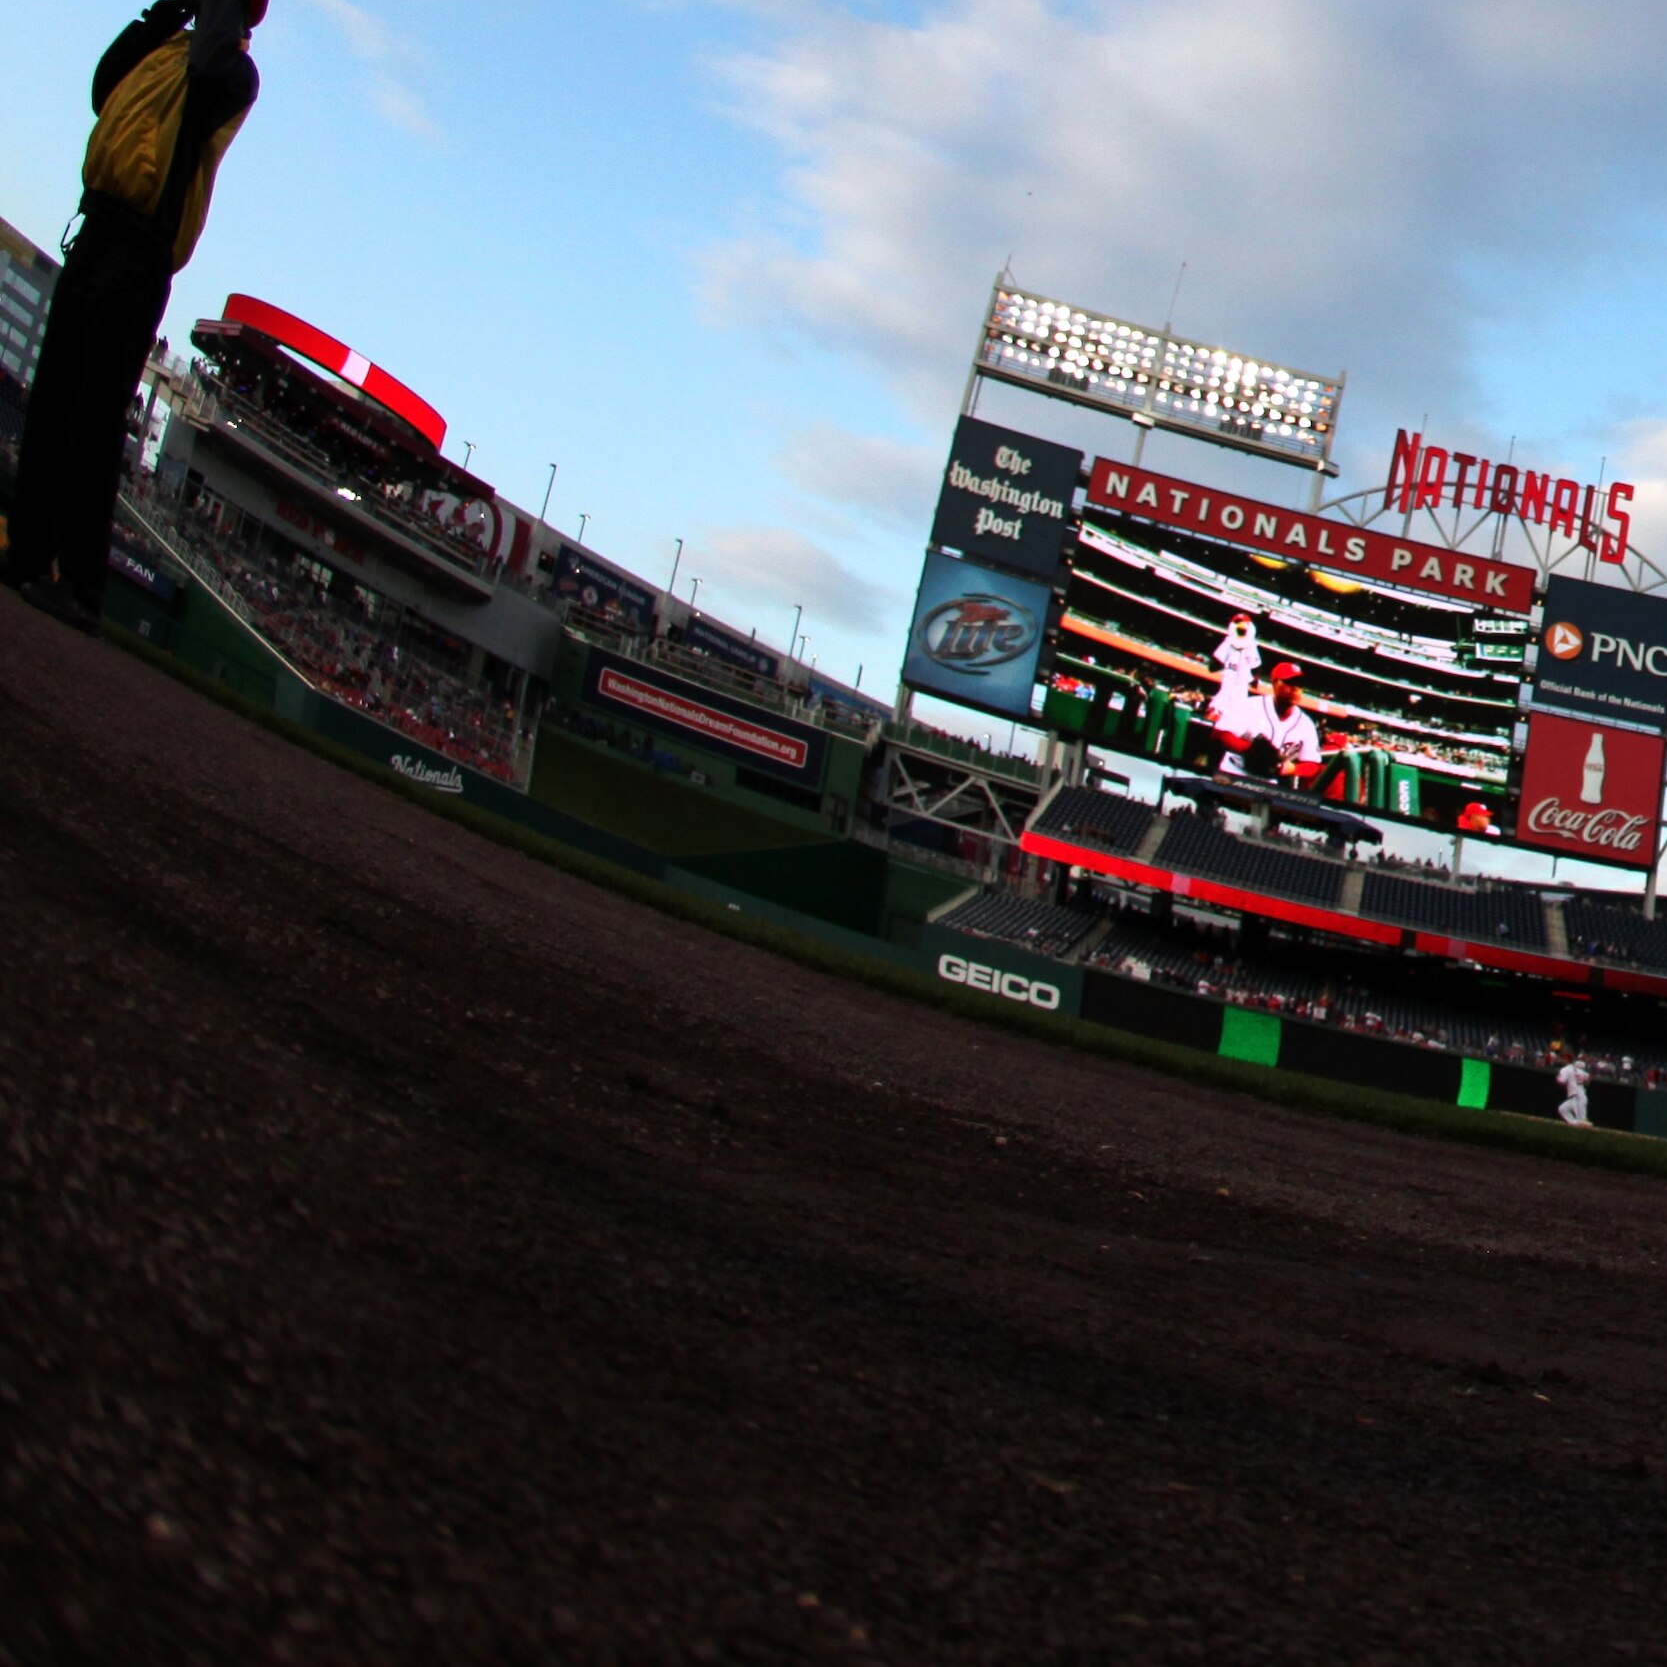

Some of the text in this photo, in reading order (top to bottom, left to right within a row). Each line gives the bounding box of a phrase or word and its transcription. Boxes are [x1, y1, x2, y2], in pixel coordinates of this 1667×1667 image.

[995, 445, 1032, 475] The
[949, 460, 1064, 519] Washington
[1384, 428, 1635, 565] NATIONALS
[974, 507, 1023, 541] Post
[1105, 471, 1509, 597] NATIONALS PARK
[126, 557, 155, 584] FAN
[607, 676, 798, 760] WashingtonNationalsDreamFoundation.org
[1540, 679, 1573, 695] Official
[1573, 686, 1597, 701] Bank
[1608, 695, 1623, 706] the
[1623, 697, 1666, 715] Nationals
[390, 753, 464, 794] Nationals
[1527, 796, 1651, 852] Coca-Cola
[937, 953, 1061, 1011] GEICO
